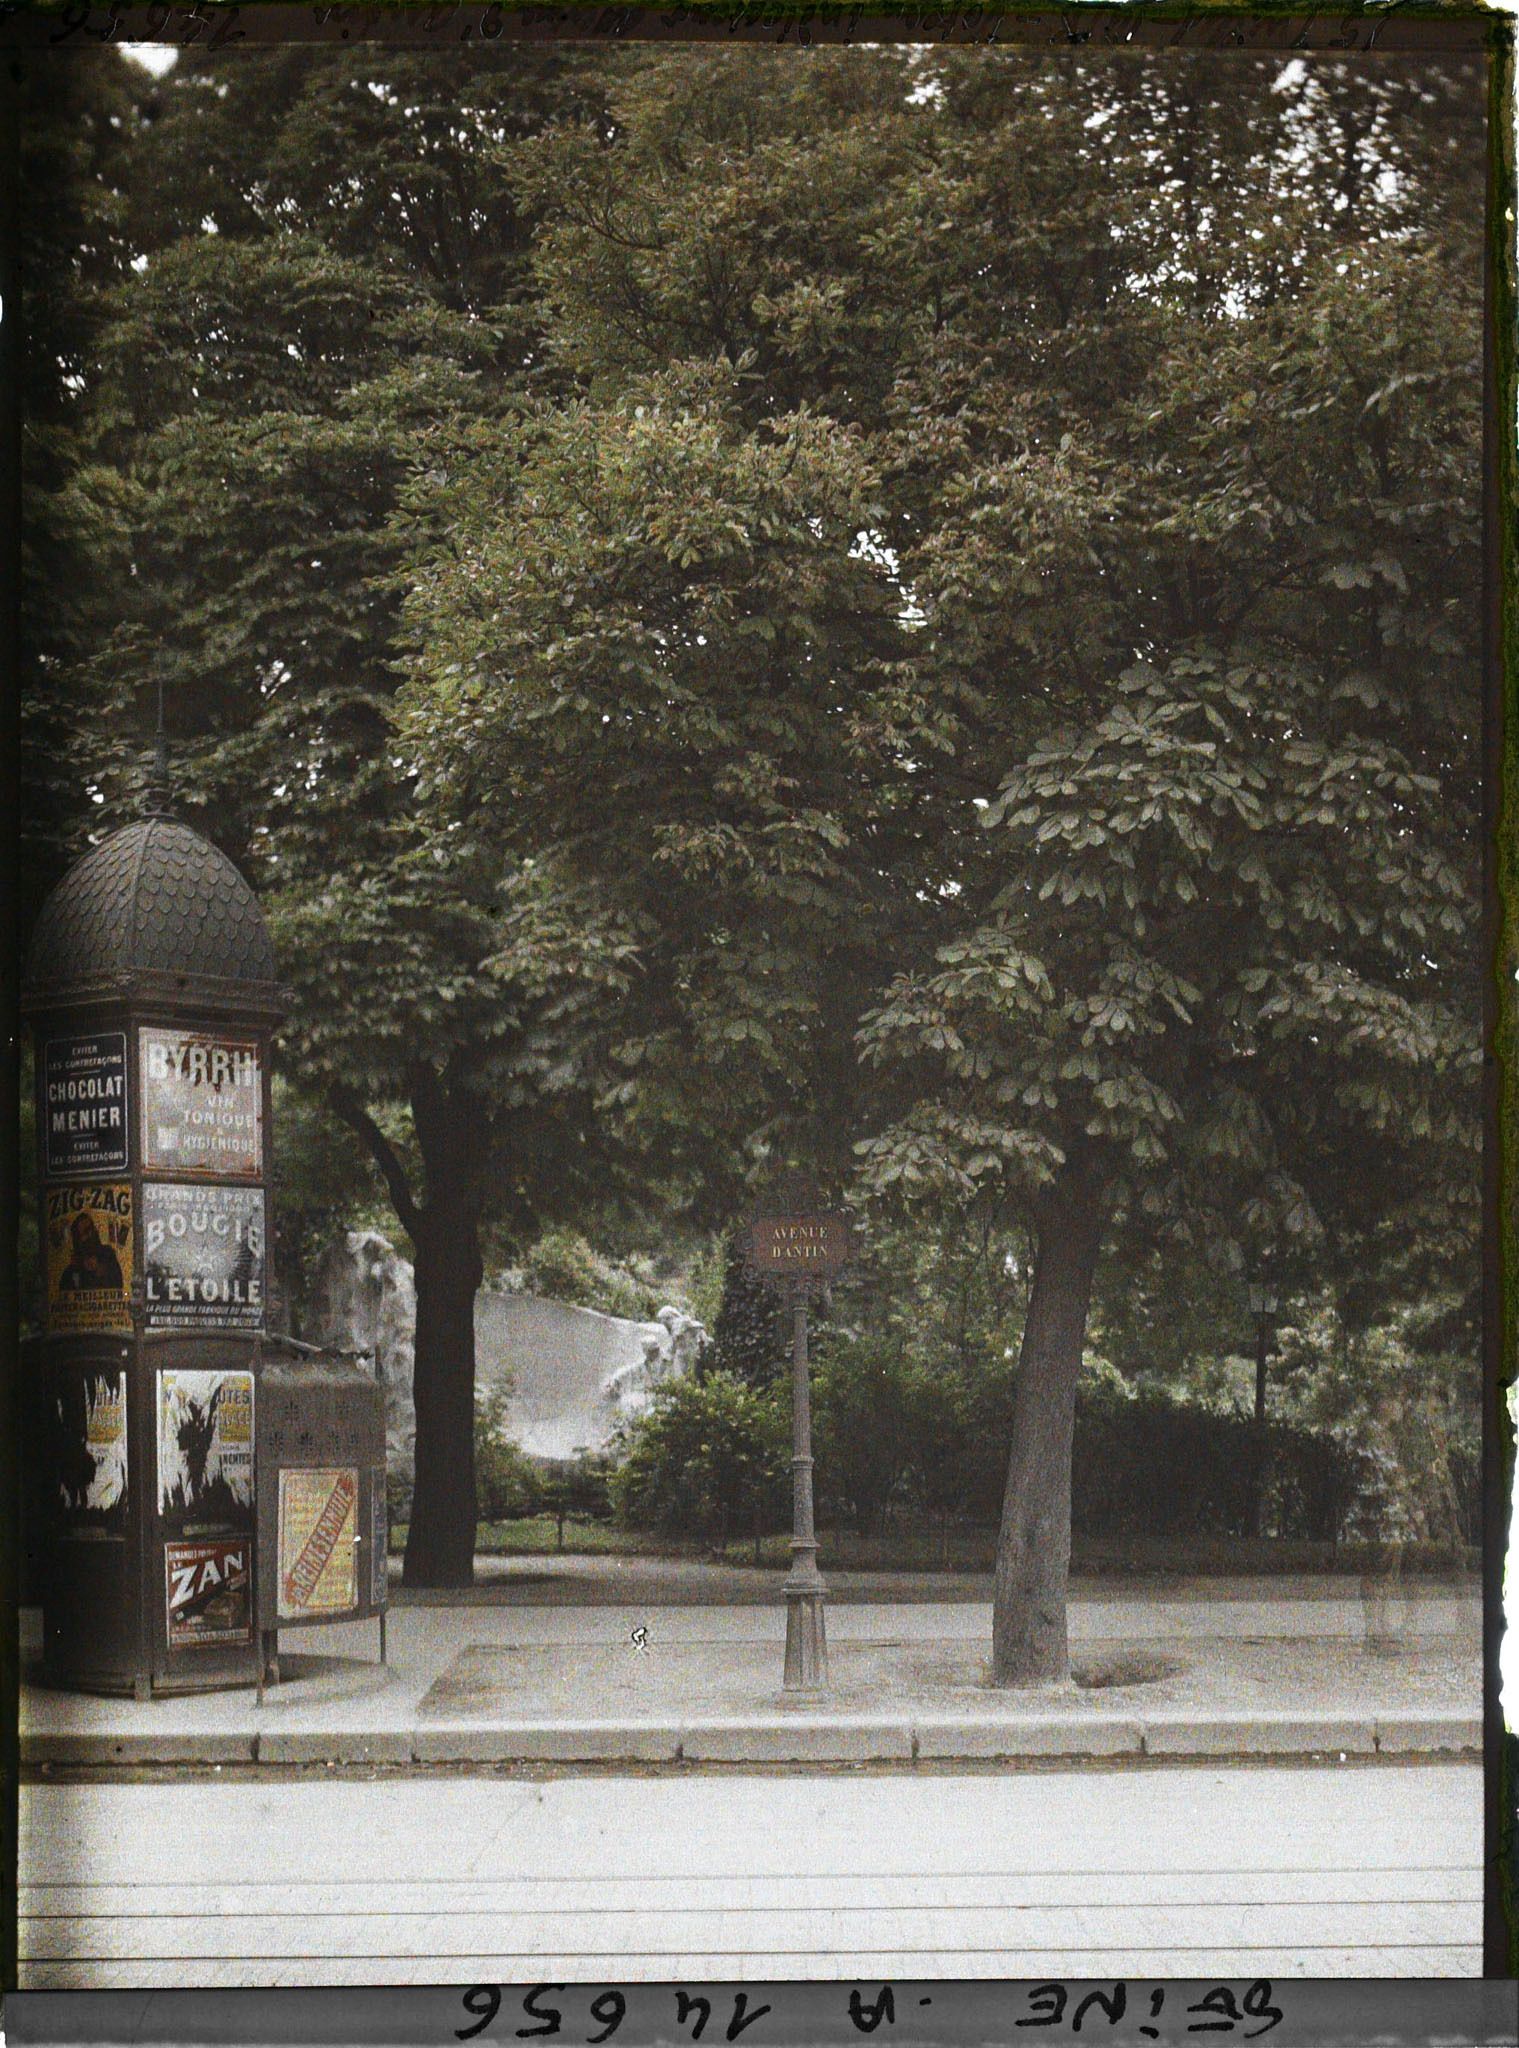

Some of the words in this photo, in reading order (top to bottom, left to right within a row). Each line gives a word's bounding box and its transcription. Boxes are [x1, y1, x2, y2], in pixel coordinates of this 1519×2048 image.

[149, 1043, 252, 1087] BYRRH
[49, 1075, 123, 1101] CHOCOLAT
[53, 1106, 121, 1132] MENIER
[184, 1109, 255, 1131] TONIQUE
[50, 1187, 130, 1221] ZIG-ZAG
[147, 1211, 261, 1258] BOUGIE
[773, 1227, 828, 1240] AVENUE
[147, 1277, 261, 1306] L'ETOILE
[170, 1551, 243, 1609] ZAN
[848, 1985, 895, 2033] A
